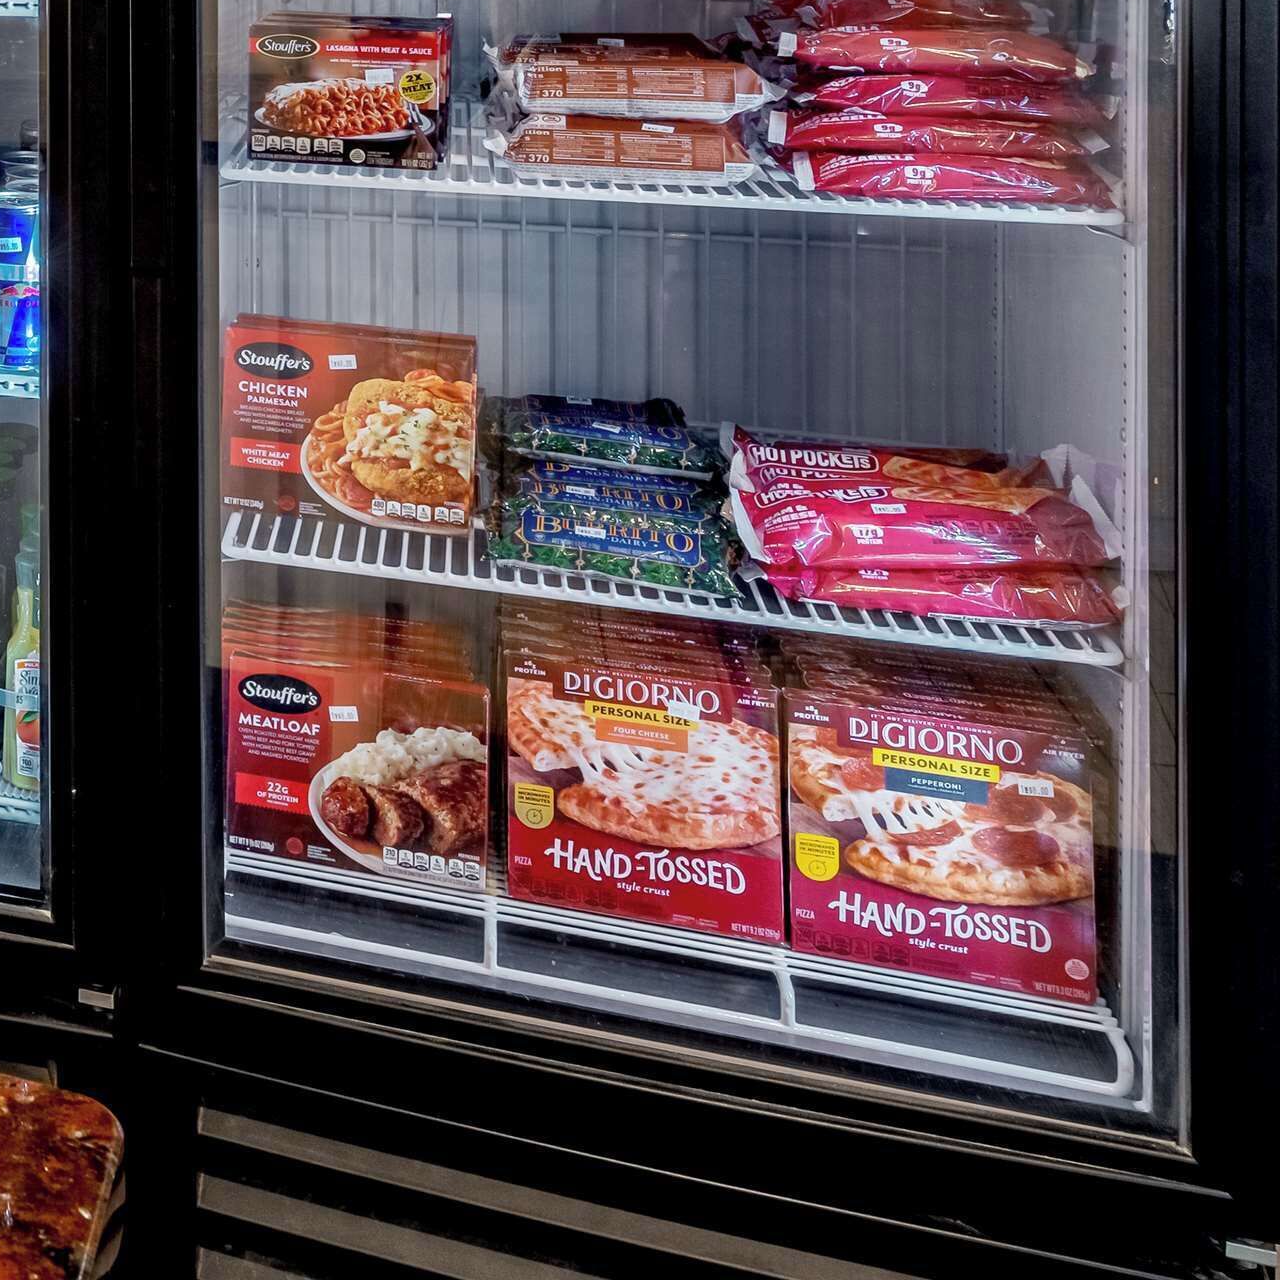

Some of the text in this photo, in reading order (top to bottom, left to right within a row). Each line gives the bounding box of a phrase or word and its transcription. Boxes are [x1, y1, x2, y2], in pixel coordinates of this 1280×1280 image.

[263, 39, 313, 53] Stouffer's
[409, 47, 432, 56] SAUCE
[406, 74, 422, 83] 2X
[401, 83, 433, 94] MEAT
[542, 88, 564, 98] 370
[528, 153, 550, 163] 370
[238, 349, 311, 371] Stouffer's
[239, 380, 307, 398] CHICKEN
[247, 395, 298, 407] PARMESAN
[241, 448, 290, 459] WHITE MEAT
[752, 446, 871, 469] HOT POCKETS
[247, 457, 284, 466] CHICKEN
[513, 667, 546, 677] PROTEIN
[242, 680, 319, 707] Stouffer's
[563, 671, 721, 715] DIGIORNO
[736, 698, 776, 709] AIR FRYER
[592, 706, 691, 727] PERSONAL SIZE
[793, 711, 830, 723] PROTEIN
[238, 712, 320, 736] MEATLOAF
[613, 726, 671, 741] FOUR CHEESE
[849, 716, 1024, 765] DIGIORNO
[1042, 748, 1085, 760] AIR FRYER
[881, 752, 991, 778] PERSONAL SIZE
[267, 781, 288, 794] 22G
[911, 776, 962, 791] PEPPERONI
[268, 793, 299, 803] PROTEIN
[514, 856, 532, 867] PIZZA
[543, 837, 747, 896] HAND-TOSSED
[616, 880, 671, 897] style crust
[795, 908, 816, 920] PIZZA
[827, 890, 1052, 954] HAND-TOSSED
[908, 937, 969, 955] style crust
